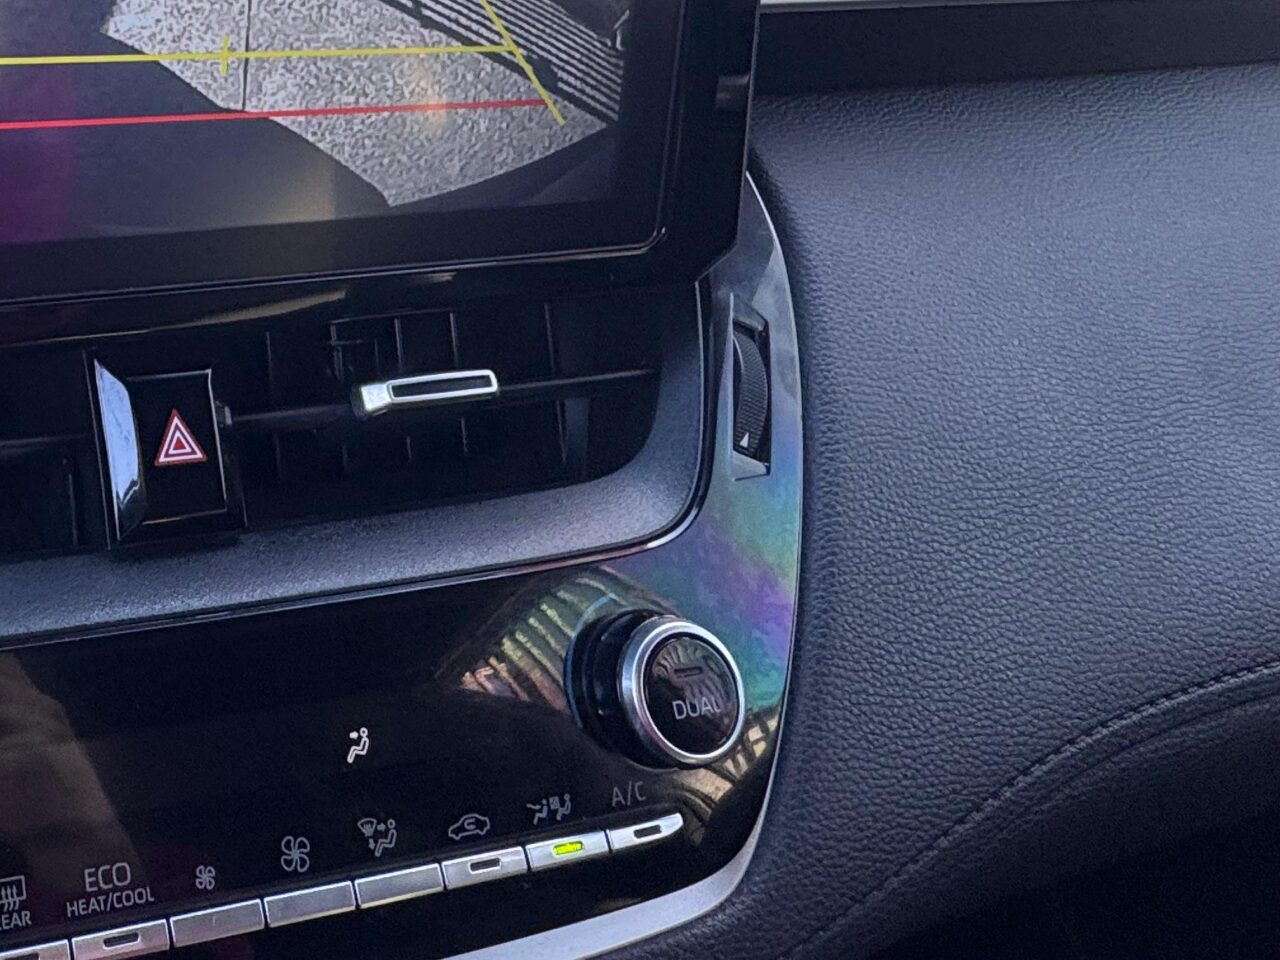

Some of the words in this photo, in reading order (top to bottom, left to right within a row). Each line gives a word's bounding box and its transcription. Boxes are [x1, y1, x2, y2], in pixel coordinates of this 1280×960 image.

[672, 696, 722, 720] DUAL
[611, 781, 646, 807] A/C
[84, 862, 131, 892] ECO
[66, 886, 155, 918] HEAT/COOL
